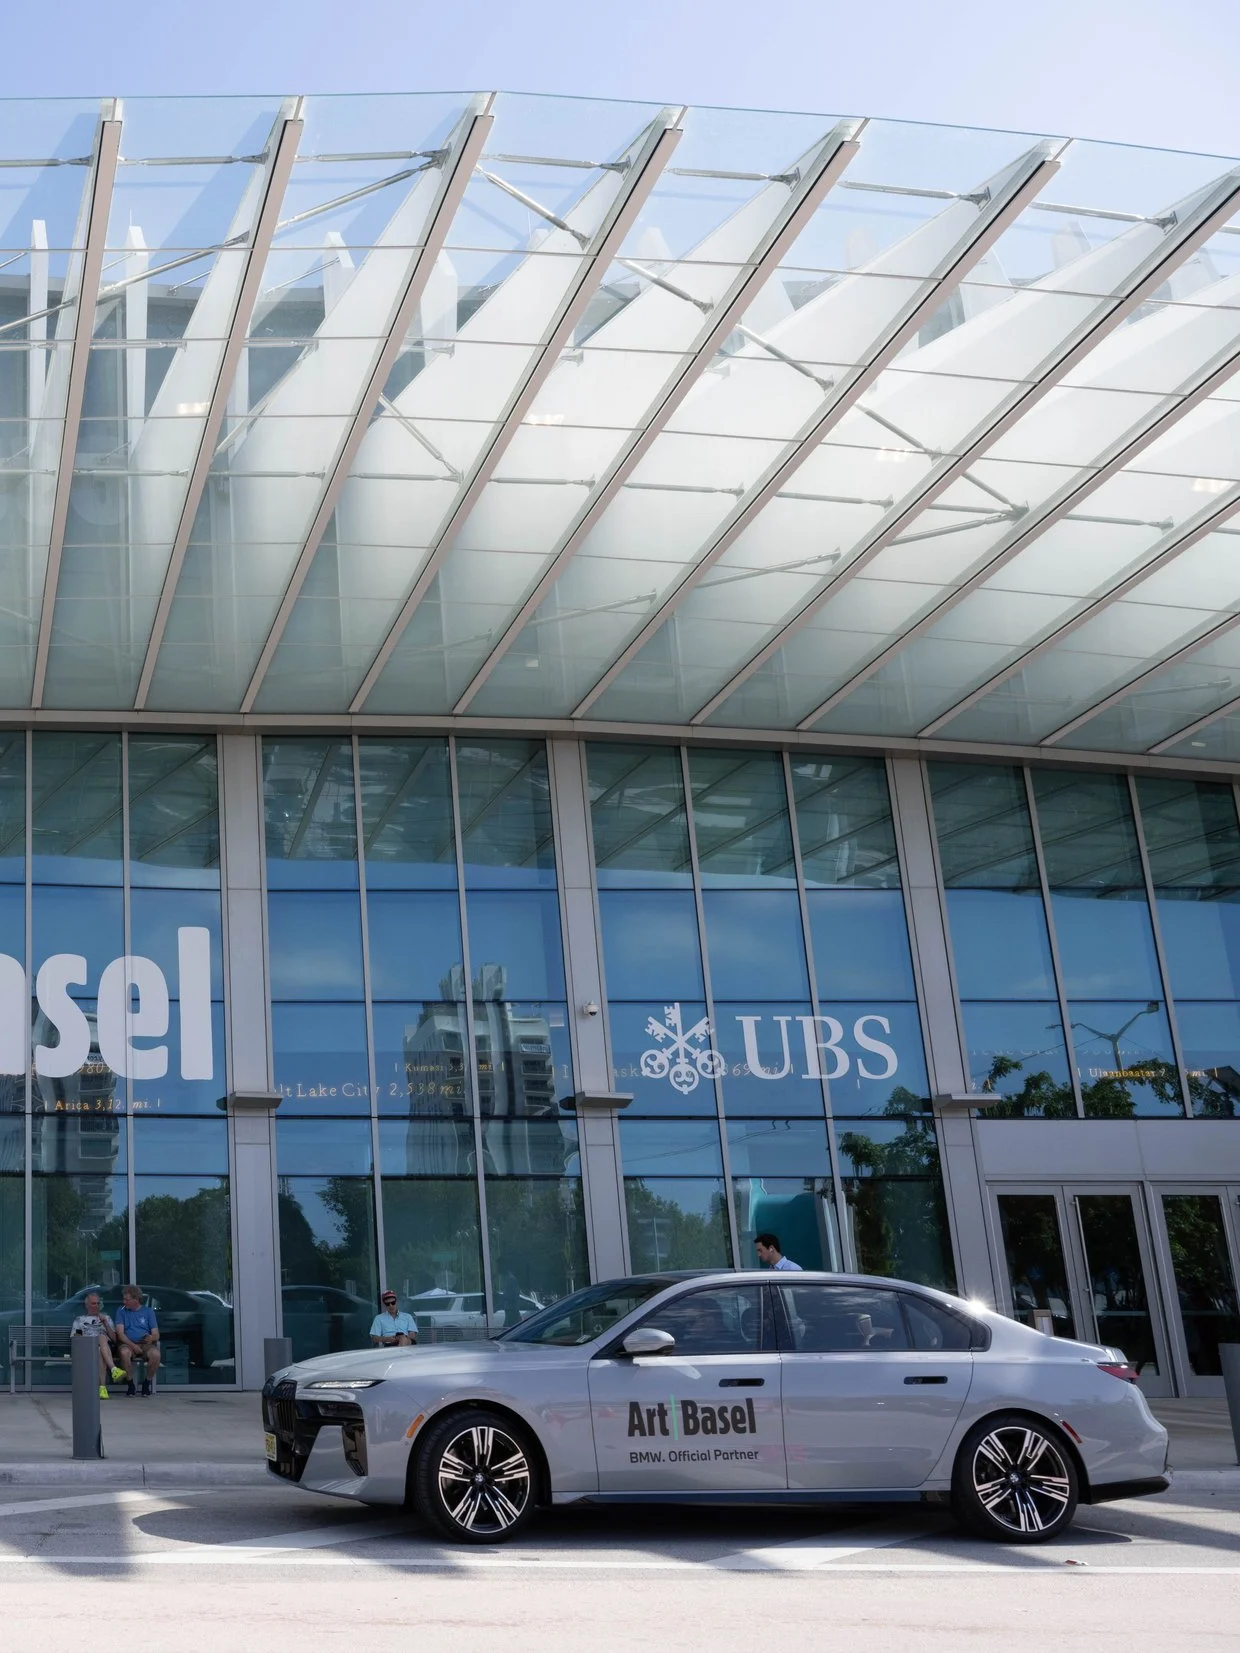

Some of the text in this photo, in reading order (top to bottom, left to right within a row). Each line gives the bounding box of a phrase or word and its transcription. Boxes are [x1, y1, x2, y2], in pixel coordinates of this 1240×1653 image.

[735, 1014, 898, 1080] UBS
[297, 1083, 337, 1097] Lake
[390, 1082, 436, 1098] 2,538
[55, 1099, 90, 1110] Arica
[628, 1398, 756, 1437] Art Basel
[630, 1449, 759, 1463] BMW. Official Partner
